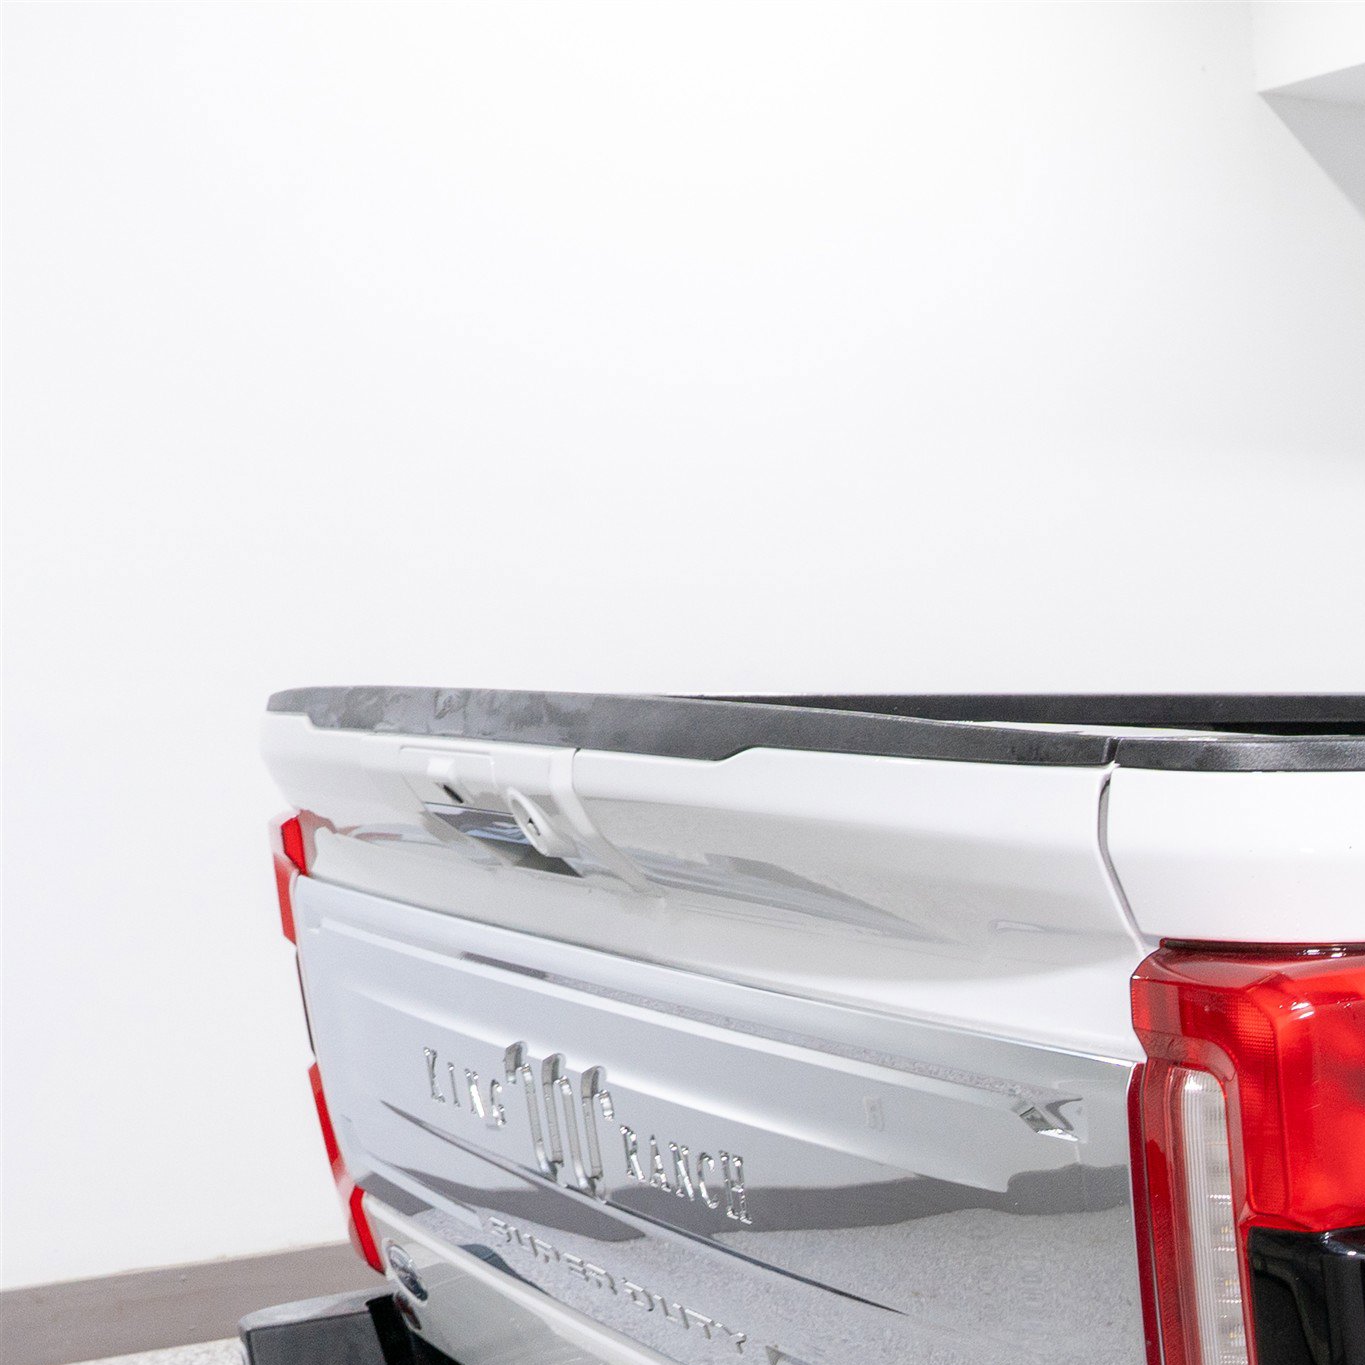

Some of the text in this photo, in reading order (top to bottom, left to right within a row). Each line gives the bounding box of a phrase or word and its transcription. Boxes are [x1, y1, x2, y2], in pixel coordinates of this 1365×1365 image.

[423, 1046, 753, 1225] KING RANCH
[489, 1216, 618, 1297] SUPER
[621, 1276, 748, 1354] DUTY
